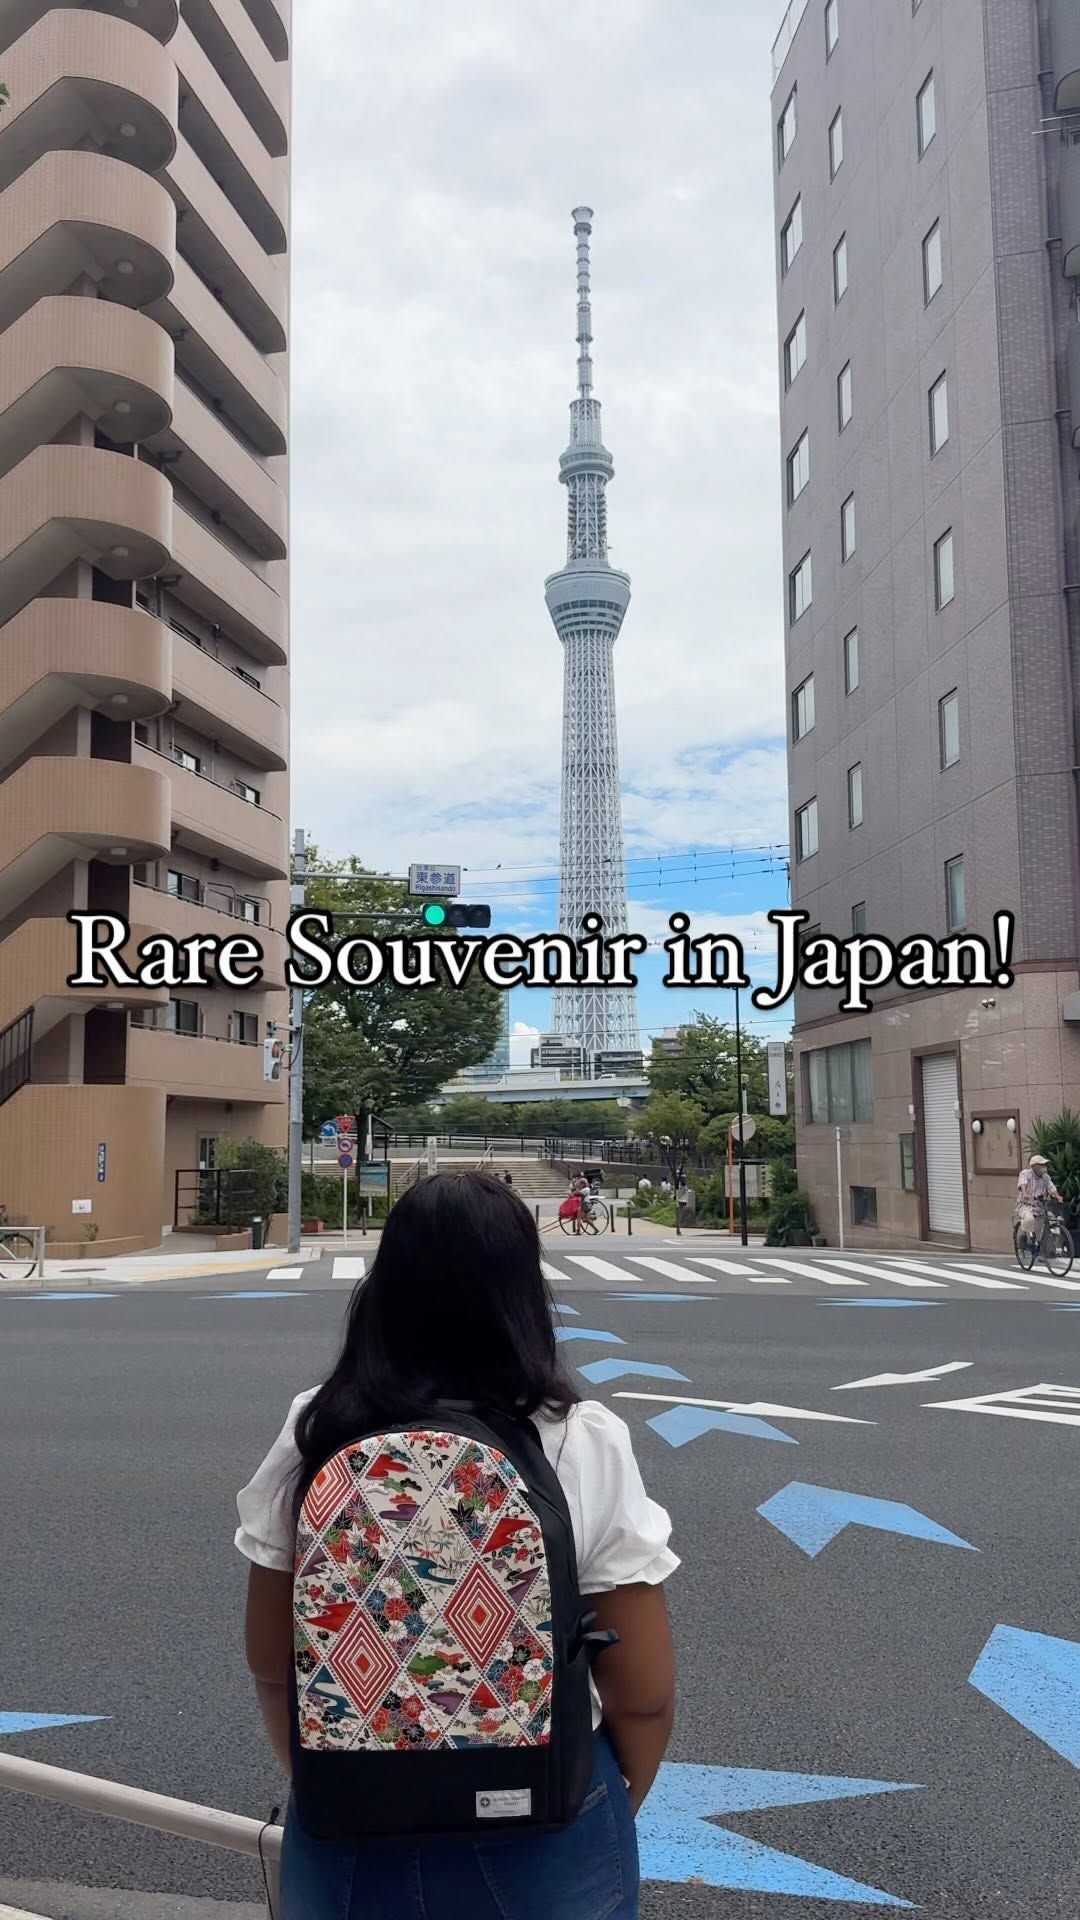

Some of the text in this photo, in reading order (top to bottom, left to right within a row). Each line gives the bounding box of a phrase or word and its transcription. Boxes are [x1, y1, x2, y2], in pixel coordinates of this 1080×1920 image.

[416, 872, 456, 884] 東参道
[415, 884, 456, 892] Higashisando
